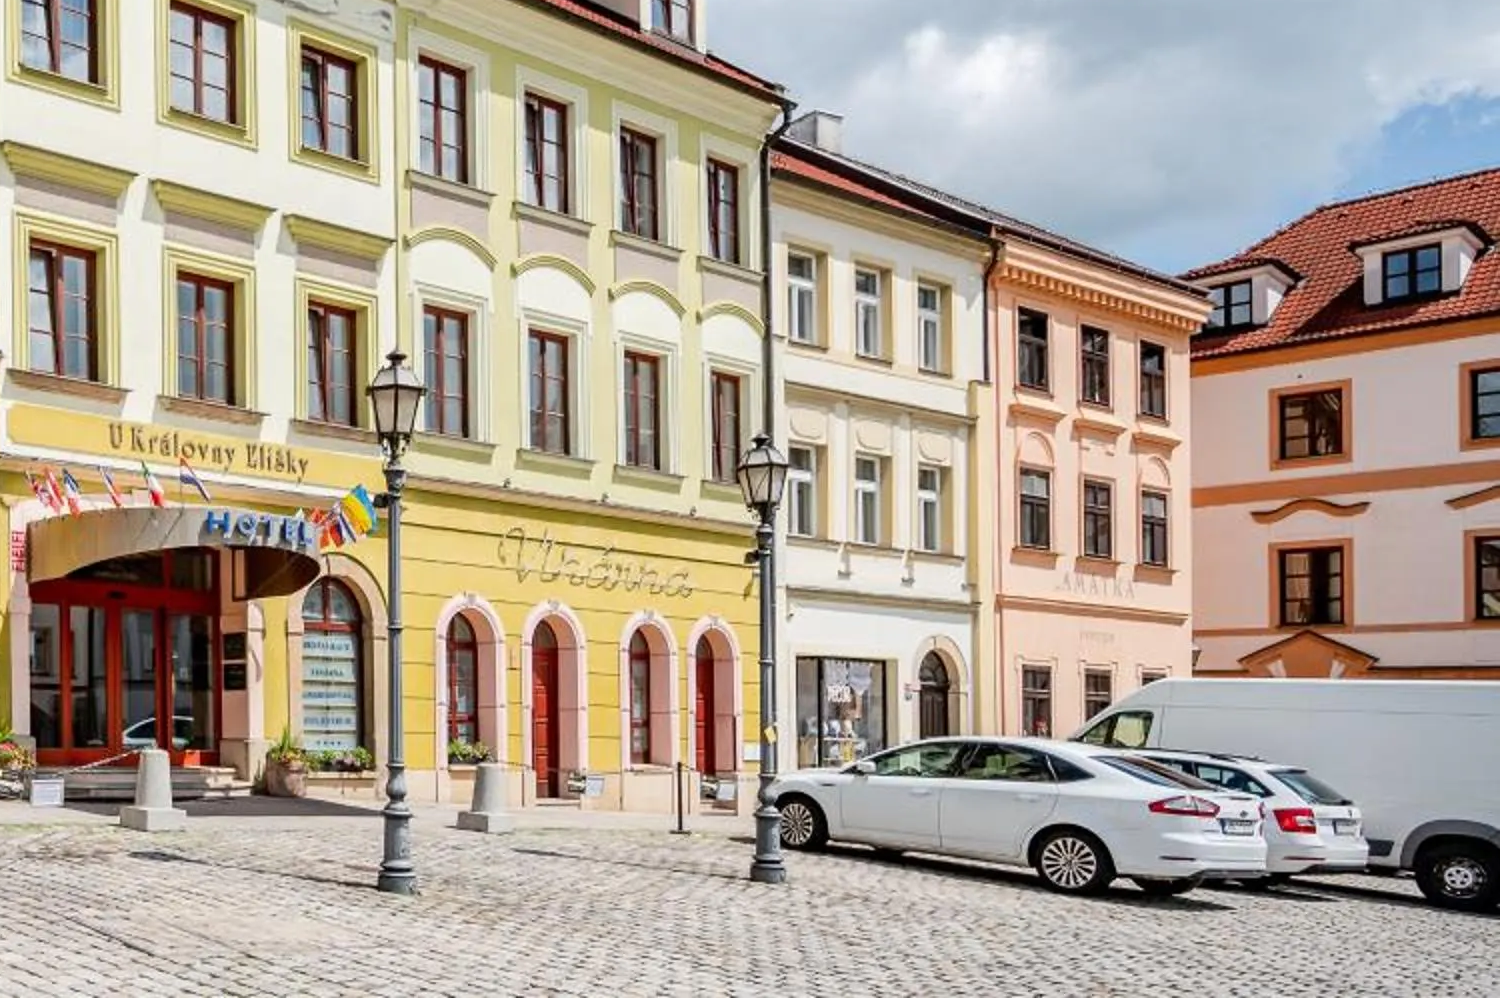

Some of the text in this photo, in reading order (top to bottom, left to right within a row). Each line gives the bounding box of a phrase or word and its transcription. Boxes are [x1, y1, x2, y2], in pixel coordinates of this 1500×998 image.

[108, 423, 123, 450] U
[130, 425, 235, 474] Královny
[206, 510, 313, 546] HOTEL
